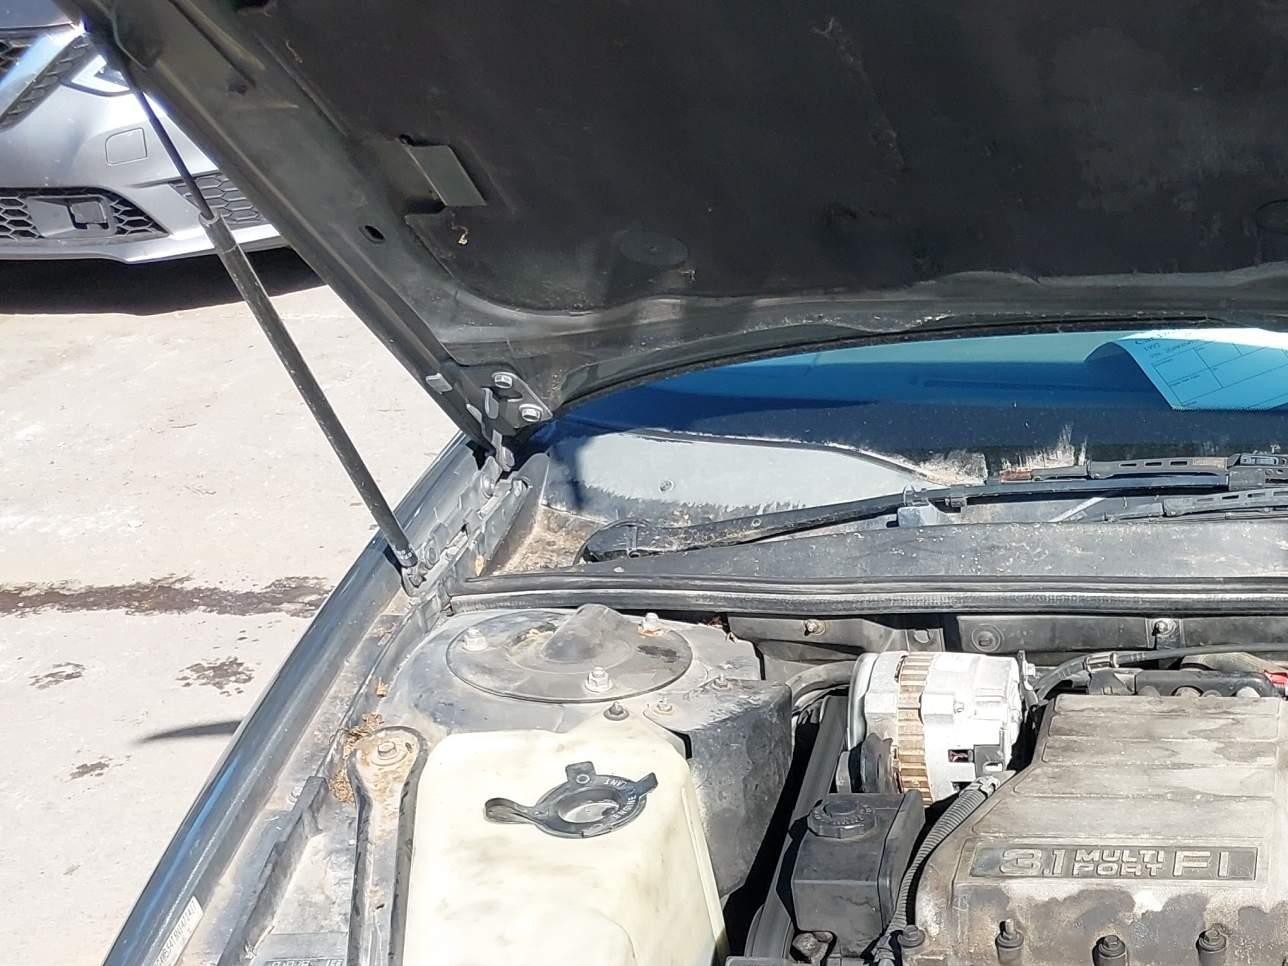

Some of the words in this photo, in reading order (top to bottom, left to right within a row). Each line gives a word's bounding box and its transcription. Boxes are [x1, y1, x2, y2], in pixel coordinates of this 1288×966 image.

[1000, 849, 1063, 876] 3.1
[1073, 849, 1165, 863] MULTI
[1172, 851, 1229, 877] FI
[1072, 863, 1162, 877] PORT
